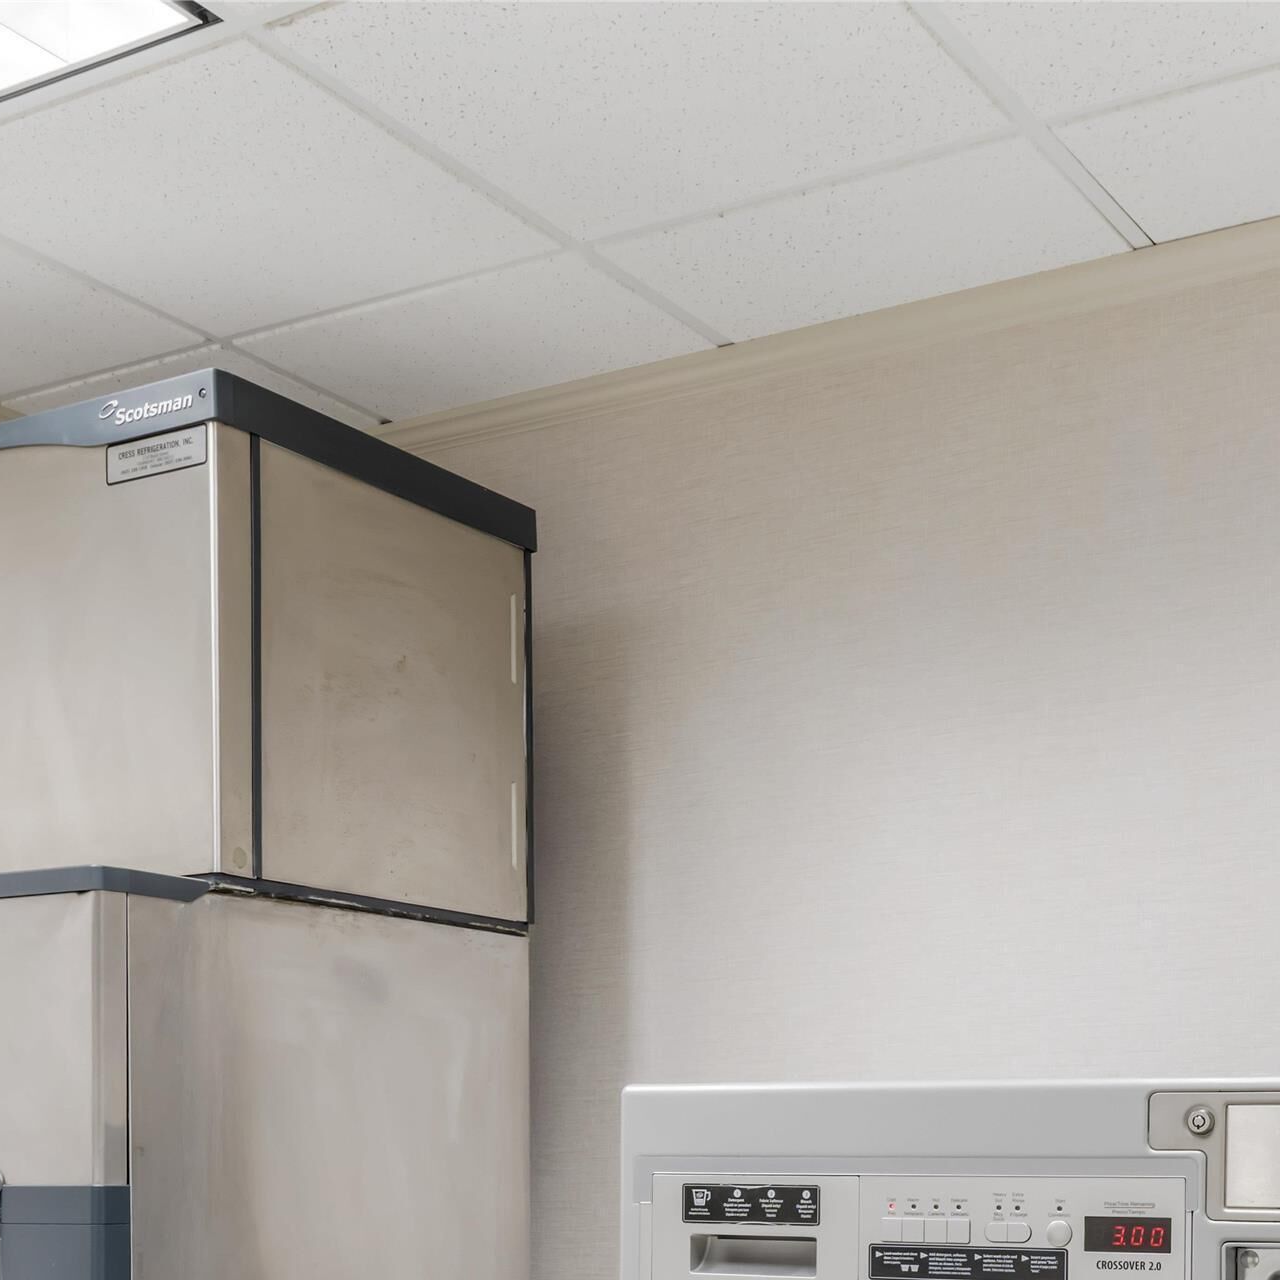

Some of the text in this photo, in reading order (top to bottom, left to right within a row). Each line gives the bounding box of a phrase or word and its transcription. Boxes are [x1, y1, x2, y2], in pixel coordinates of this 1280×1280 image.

[115, 394, 193, 425] Scotsman
[118, 449, 136, 461] CRESS
[1112, 1225, 1164, 1247] 3.00
[1096, 1260, 1162, 1271] CROSSOVER 2.0
